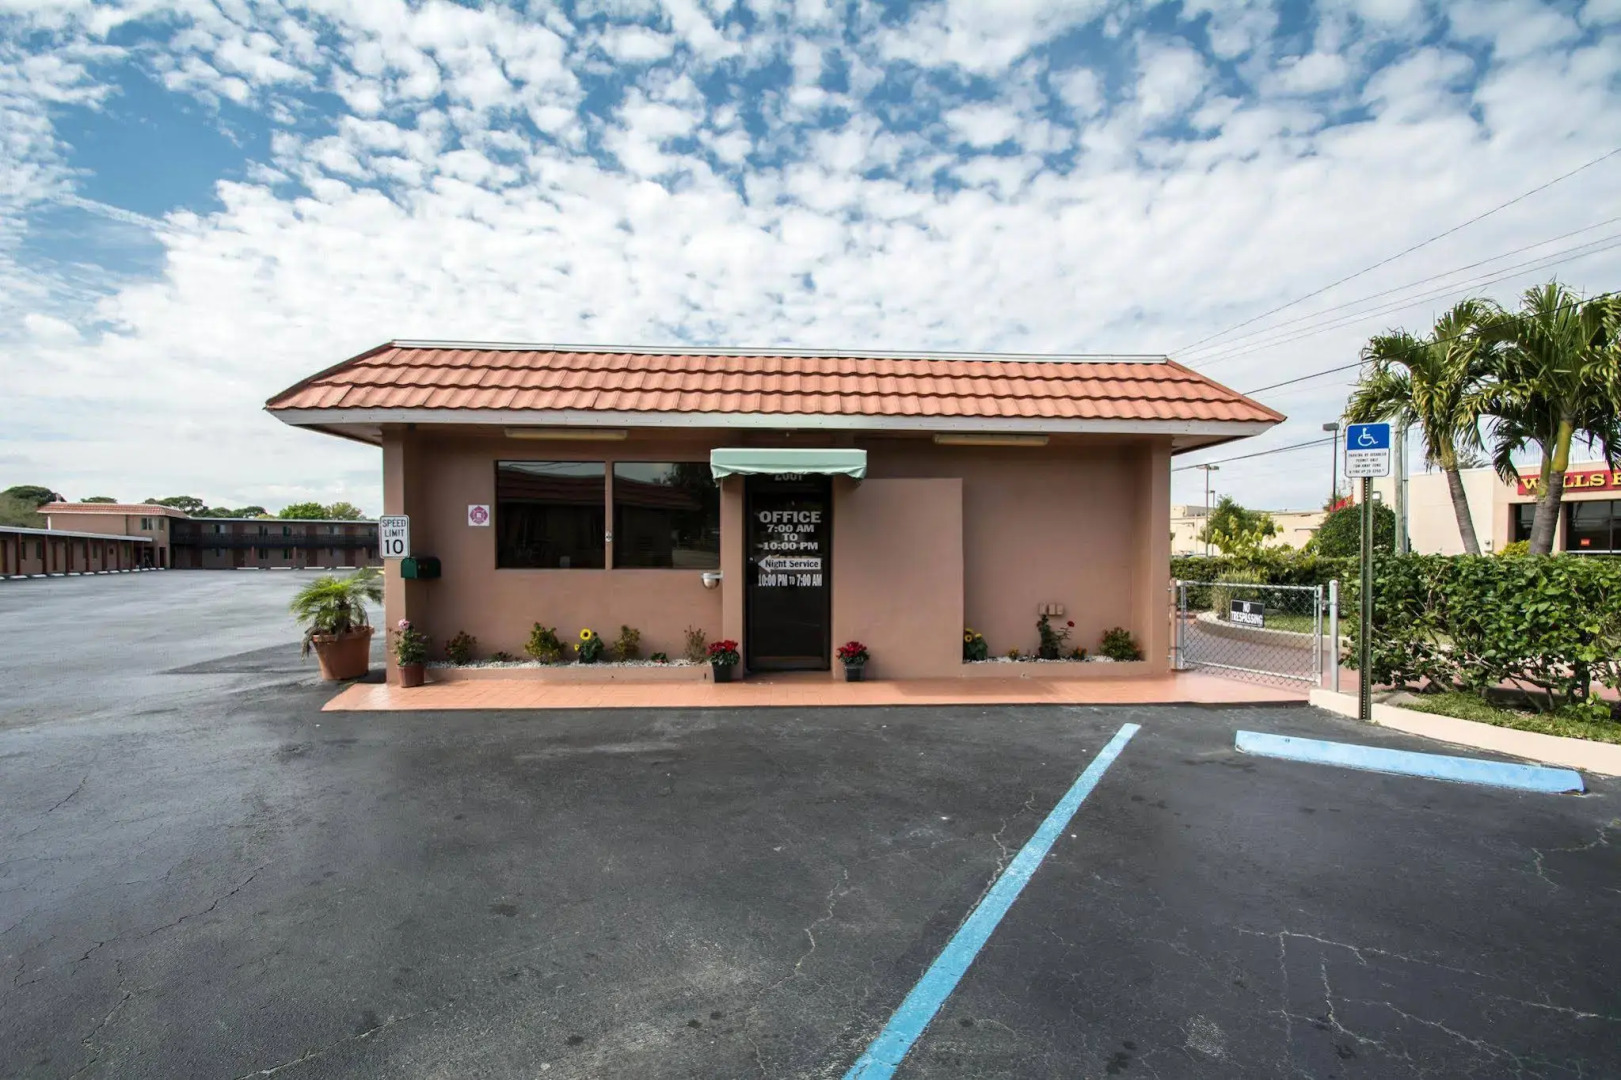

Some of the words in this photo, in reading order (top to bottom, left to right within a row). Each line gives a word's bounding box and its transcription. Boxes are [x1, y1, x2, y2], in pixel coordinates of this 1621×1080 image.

[1521, 472, 1606, 490] WLLS
[759, 510, 821, 523] OFFICE
[382, 518, 406, 528] SPEED
[767, 524, 793, 533] 7:00
[796, 524, 815, 533] AM
[384, 529, 405, 537] LIMIT
[782, 533, 798, 541] TO
[385, 539, 404, 554] 10
[763, 542, 797, 550] 10:00
[799, 542, 819, 550] PM
[765, 560, 787, 569] Night
[789, 560, 819, 568] Service
[758, 573, 777, 587] 10:00
[777, 573, 788, 587] PM
[796, 573, 811, 587] 7:00
[812, 573, 823, 587] AM
[1242, 601, 1250, 613] NO
[1231, 610, 1264, 626] TRESPASSING
